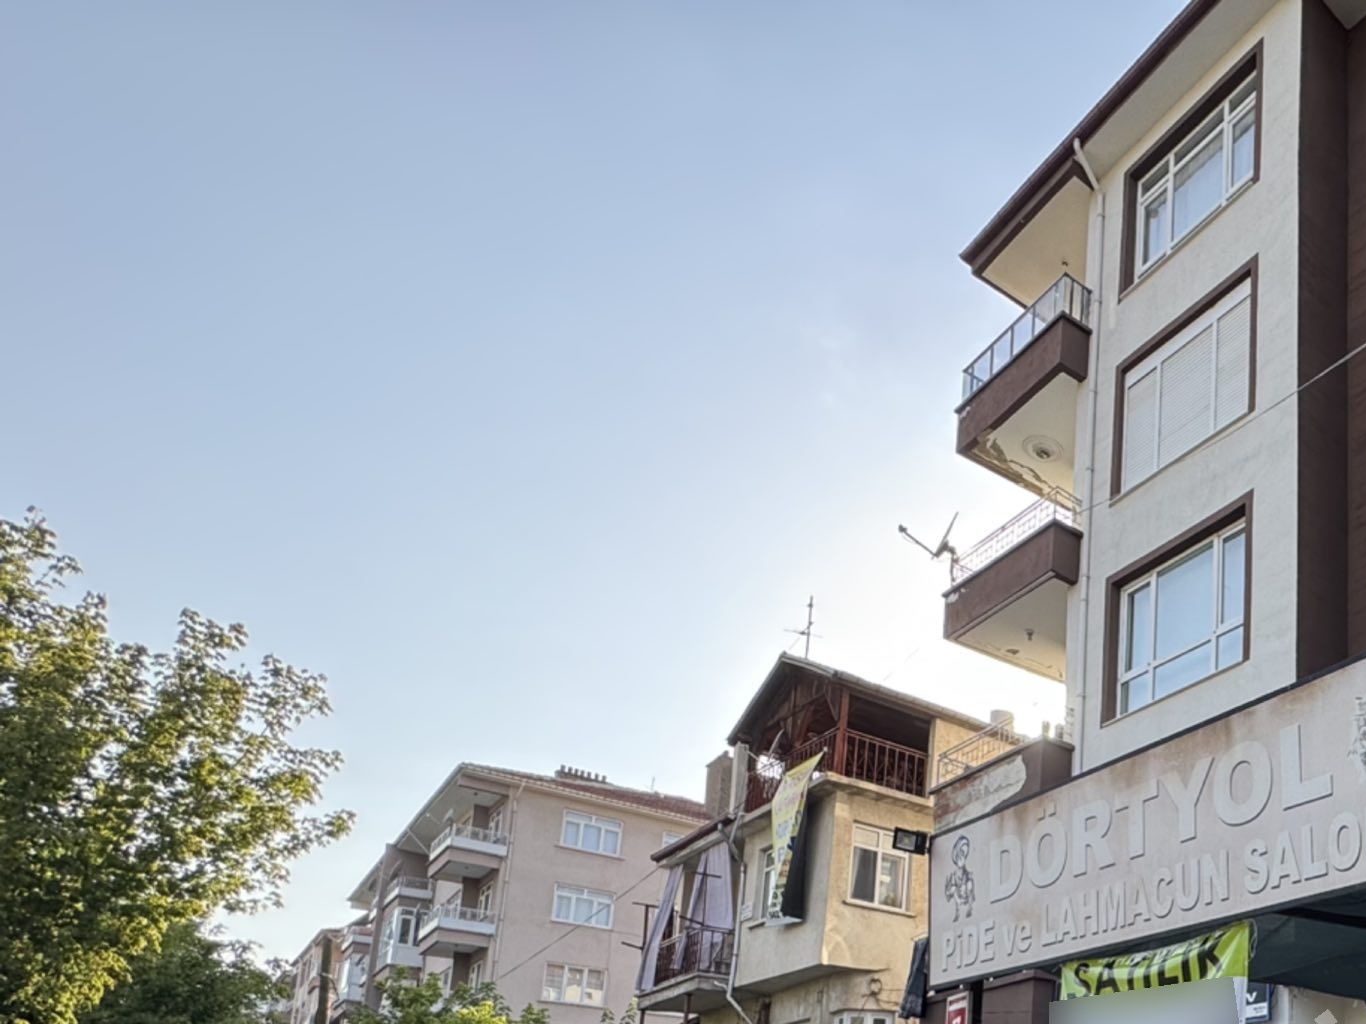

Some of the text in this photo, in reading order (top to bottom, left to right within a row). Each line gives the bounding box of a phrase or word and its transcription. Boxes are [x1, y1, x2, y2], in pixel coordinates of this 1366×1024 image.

[988, 722, 1335, 904] DÖRTYOL
[1003, 922, 1033, 957] ve
[1040, 848, 1230, 949] LAHMACUN
